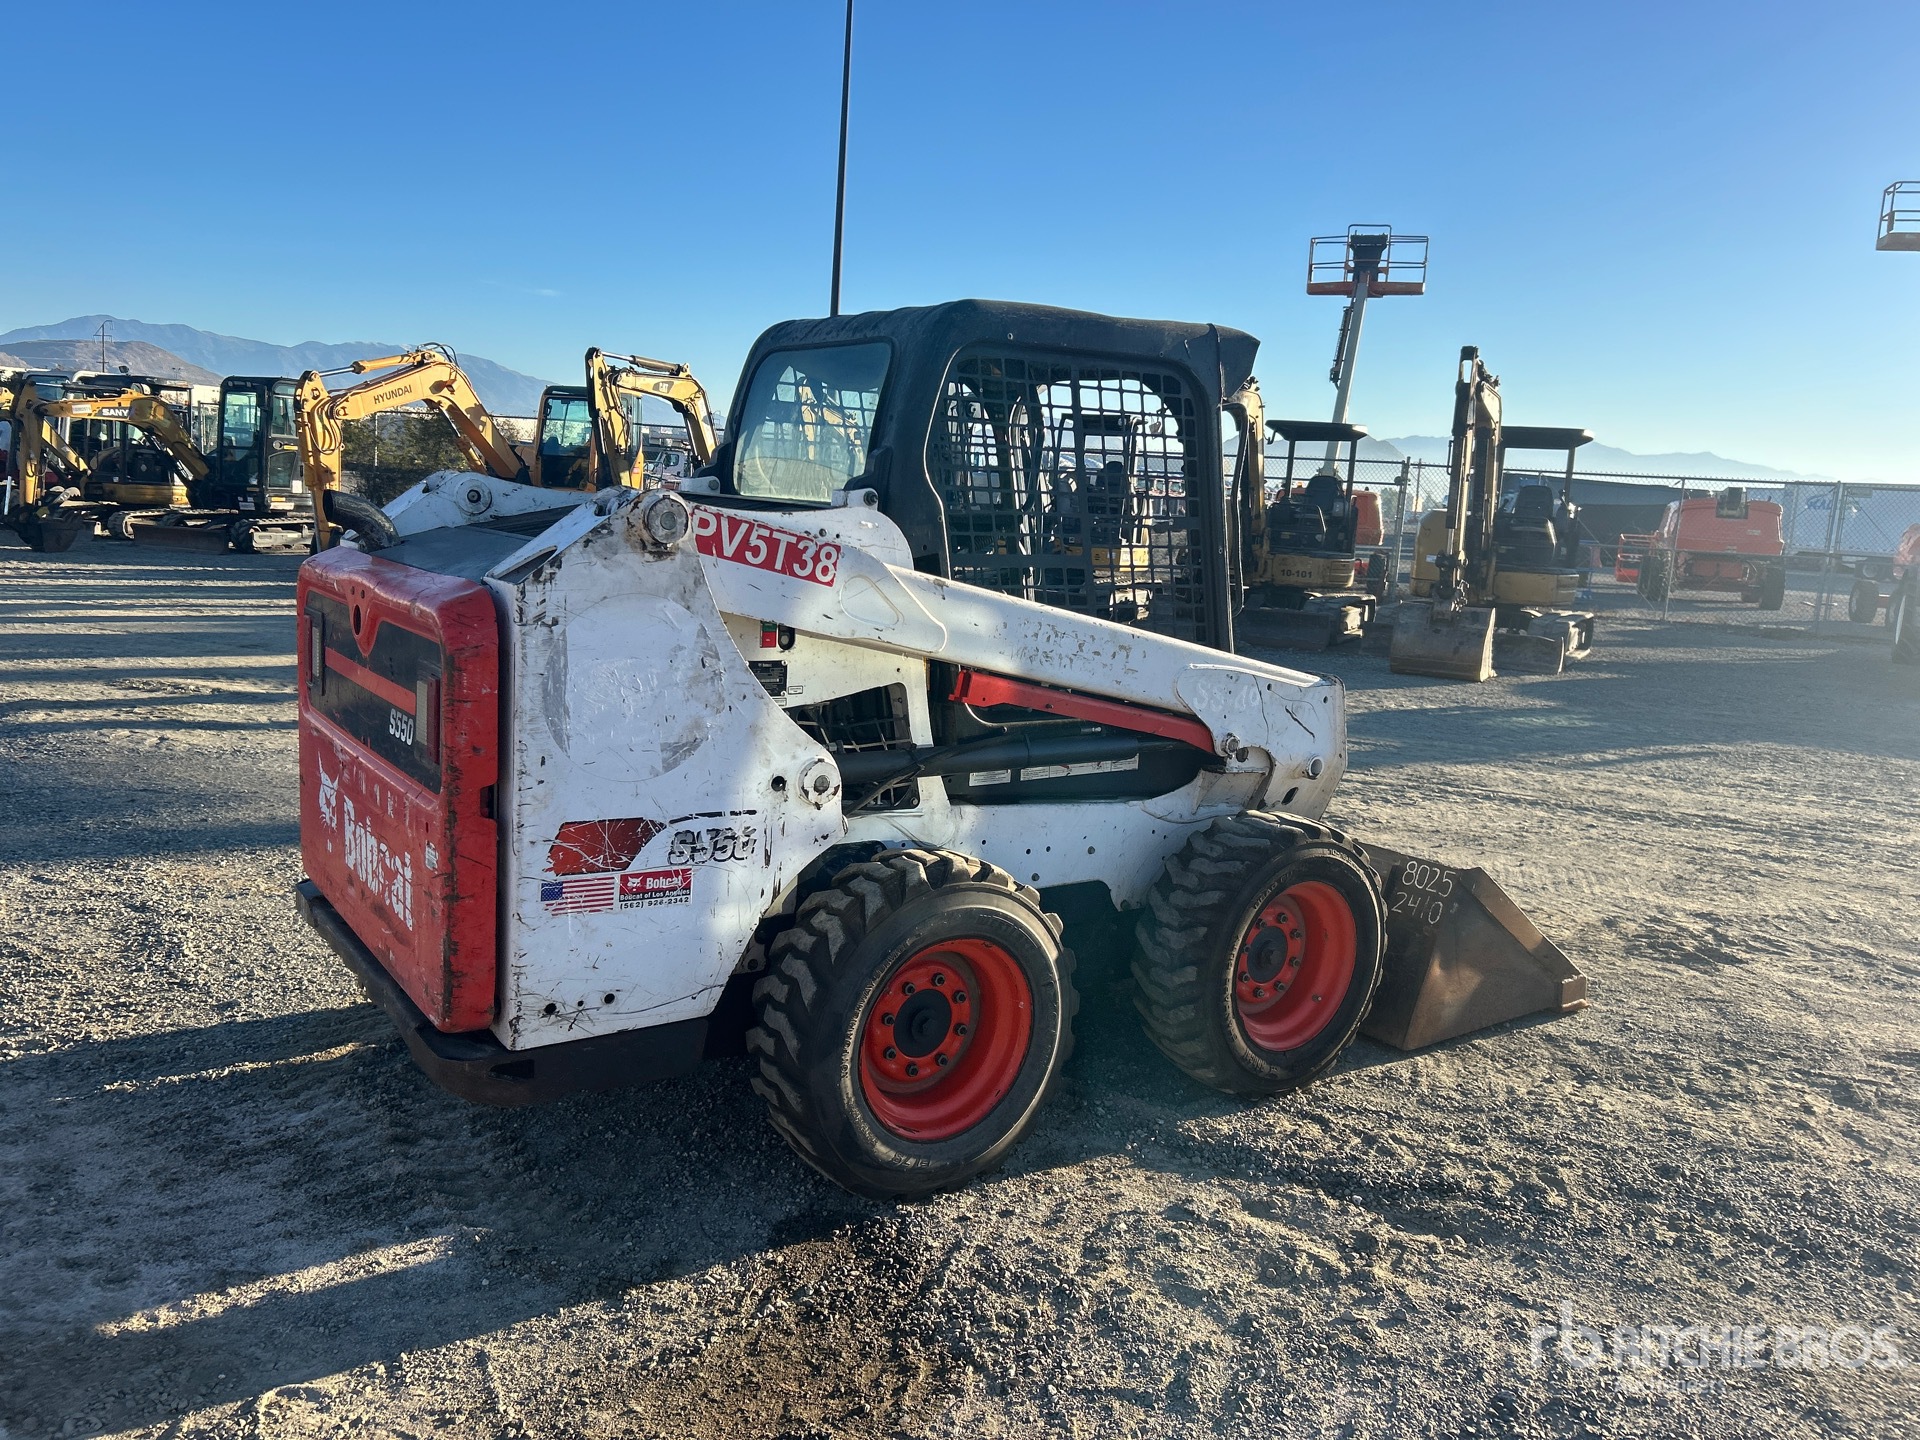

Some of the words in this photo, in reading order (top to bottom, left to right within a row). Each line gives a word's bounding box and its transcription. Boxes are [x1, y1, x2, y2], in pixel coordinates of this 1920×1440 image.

[373, 384, 412, 404] HYUNDAI
[101, 408, 129, 417] SANY
[692, 508, 838, 583] PV5T38
[1280, 569, 1312, 578] 10-101
[389, 708, 414, 746] S550
[646, 875, 682, 890] Bobcat
[1402, 861, 1456, 897] 8025
[620, 893, 643, 901] Bobcat
[620, 901, 644, 909] (562)
[1391, 891, 1443, 924] 2410
